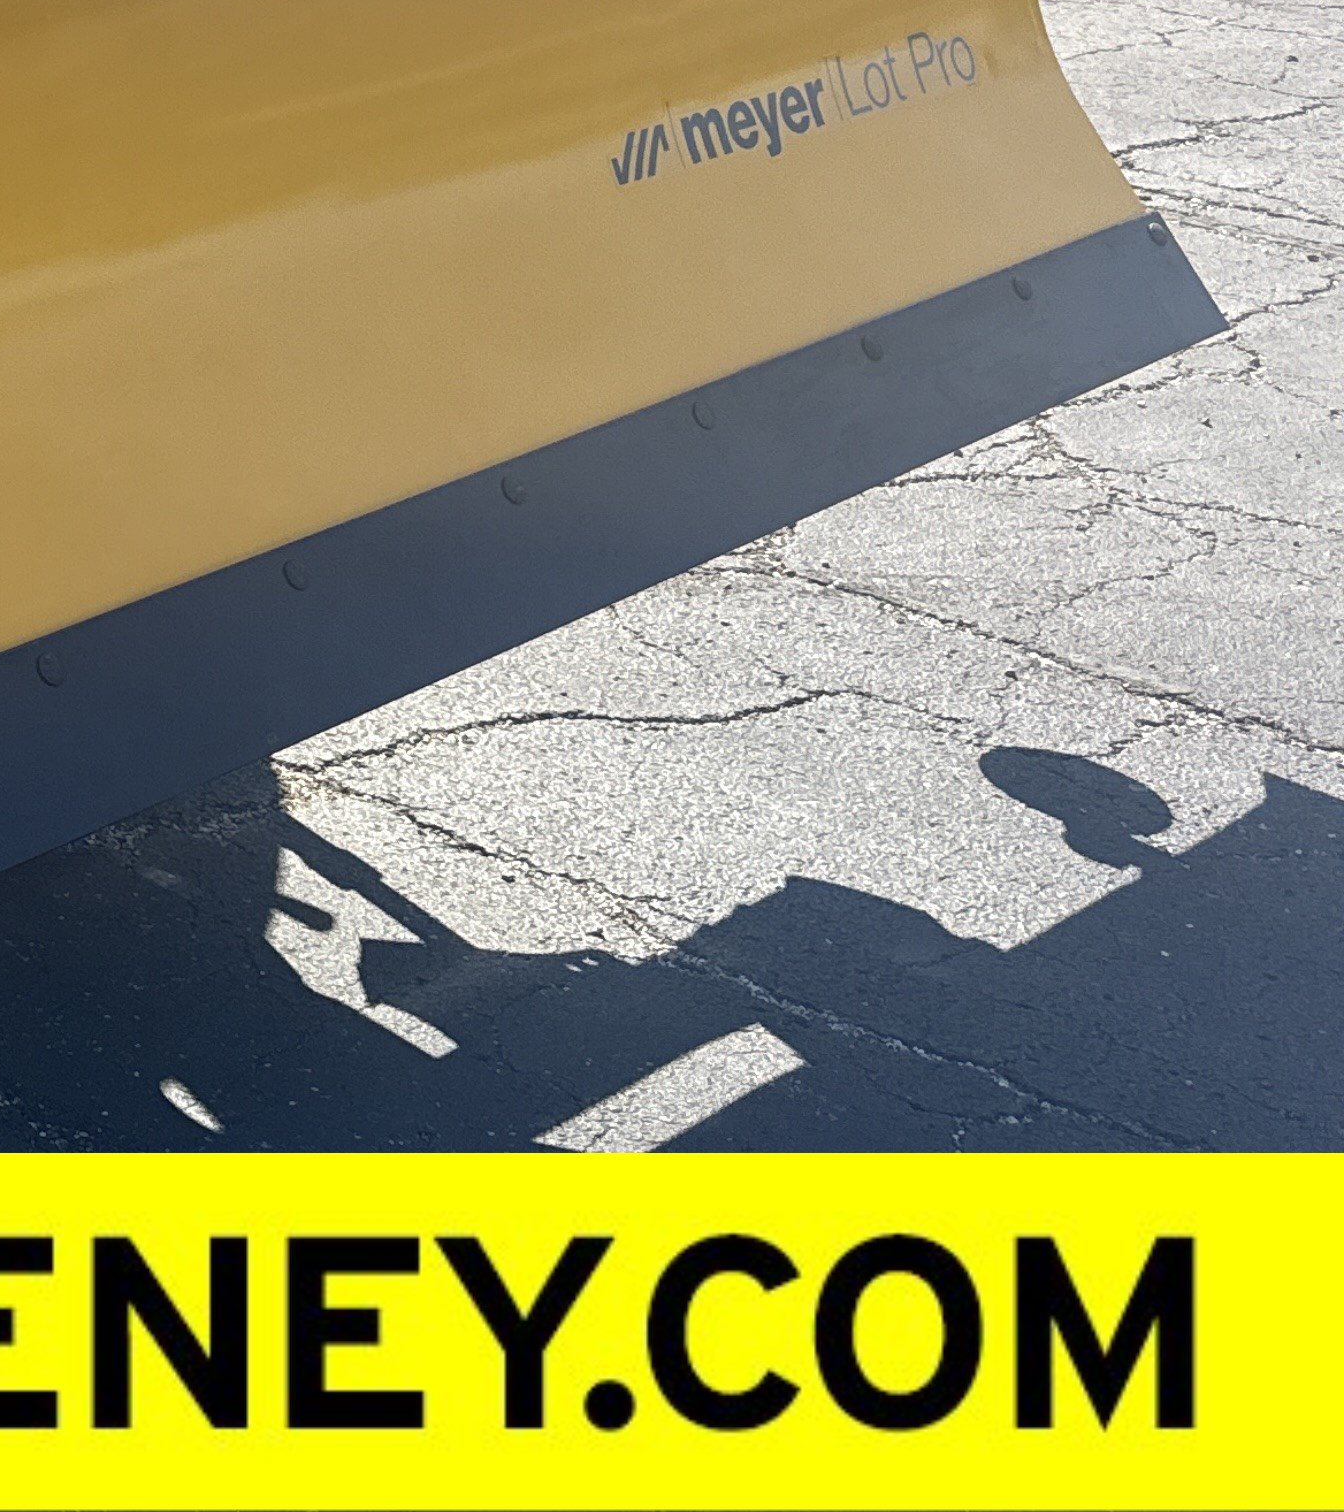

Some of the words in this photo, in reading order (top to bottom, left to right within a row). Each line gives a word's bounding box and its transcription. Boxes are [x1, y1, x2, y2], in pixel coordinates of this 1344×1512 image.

[679, 77, 826, 164] meyer
[836, 45, 907, 116] Lot
[908, 31, 976, 94] Pro
